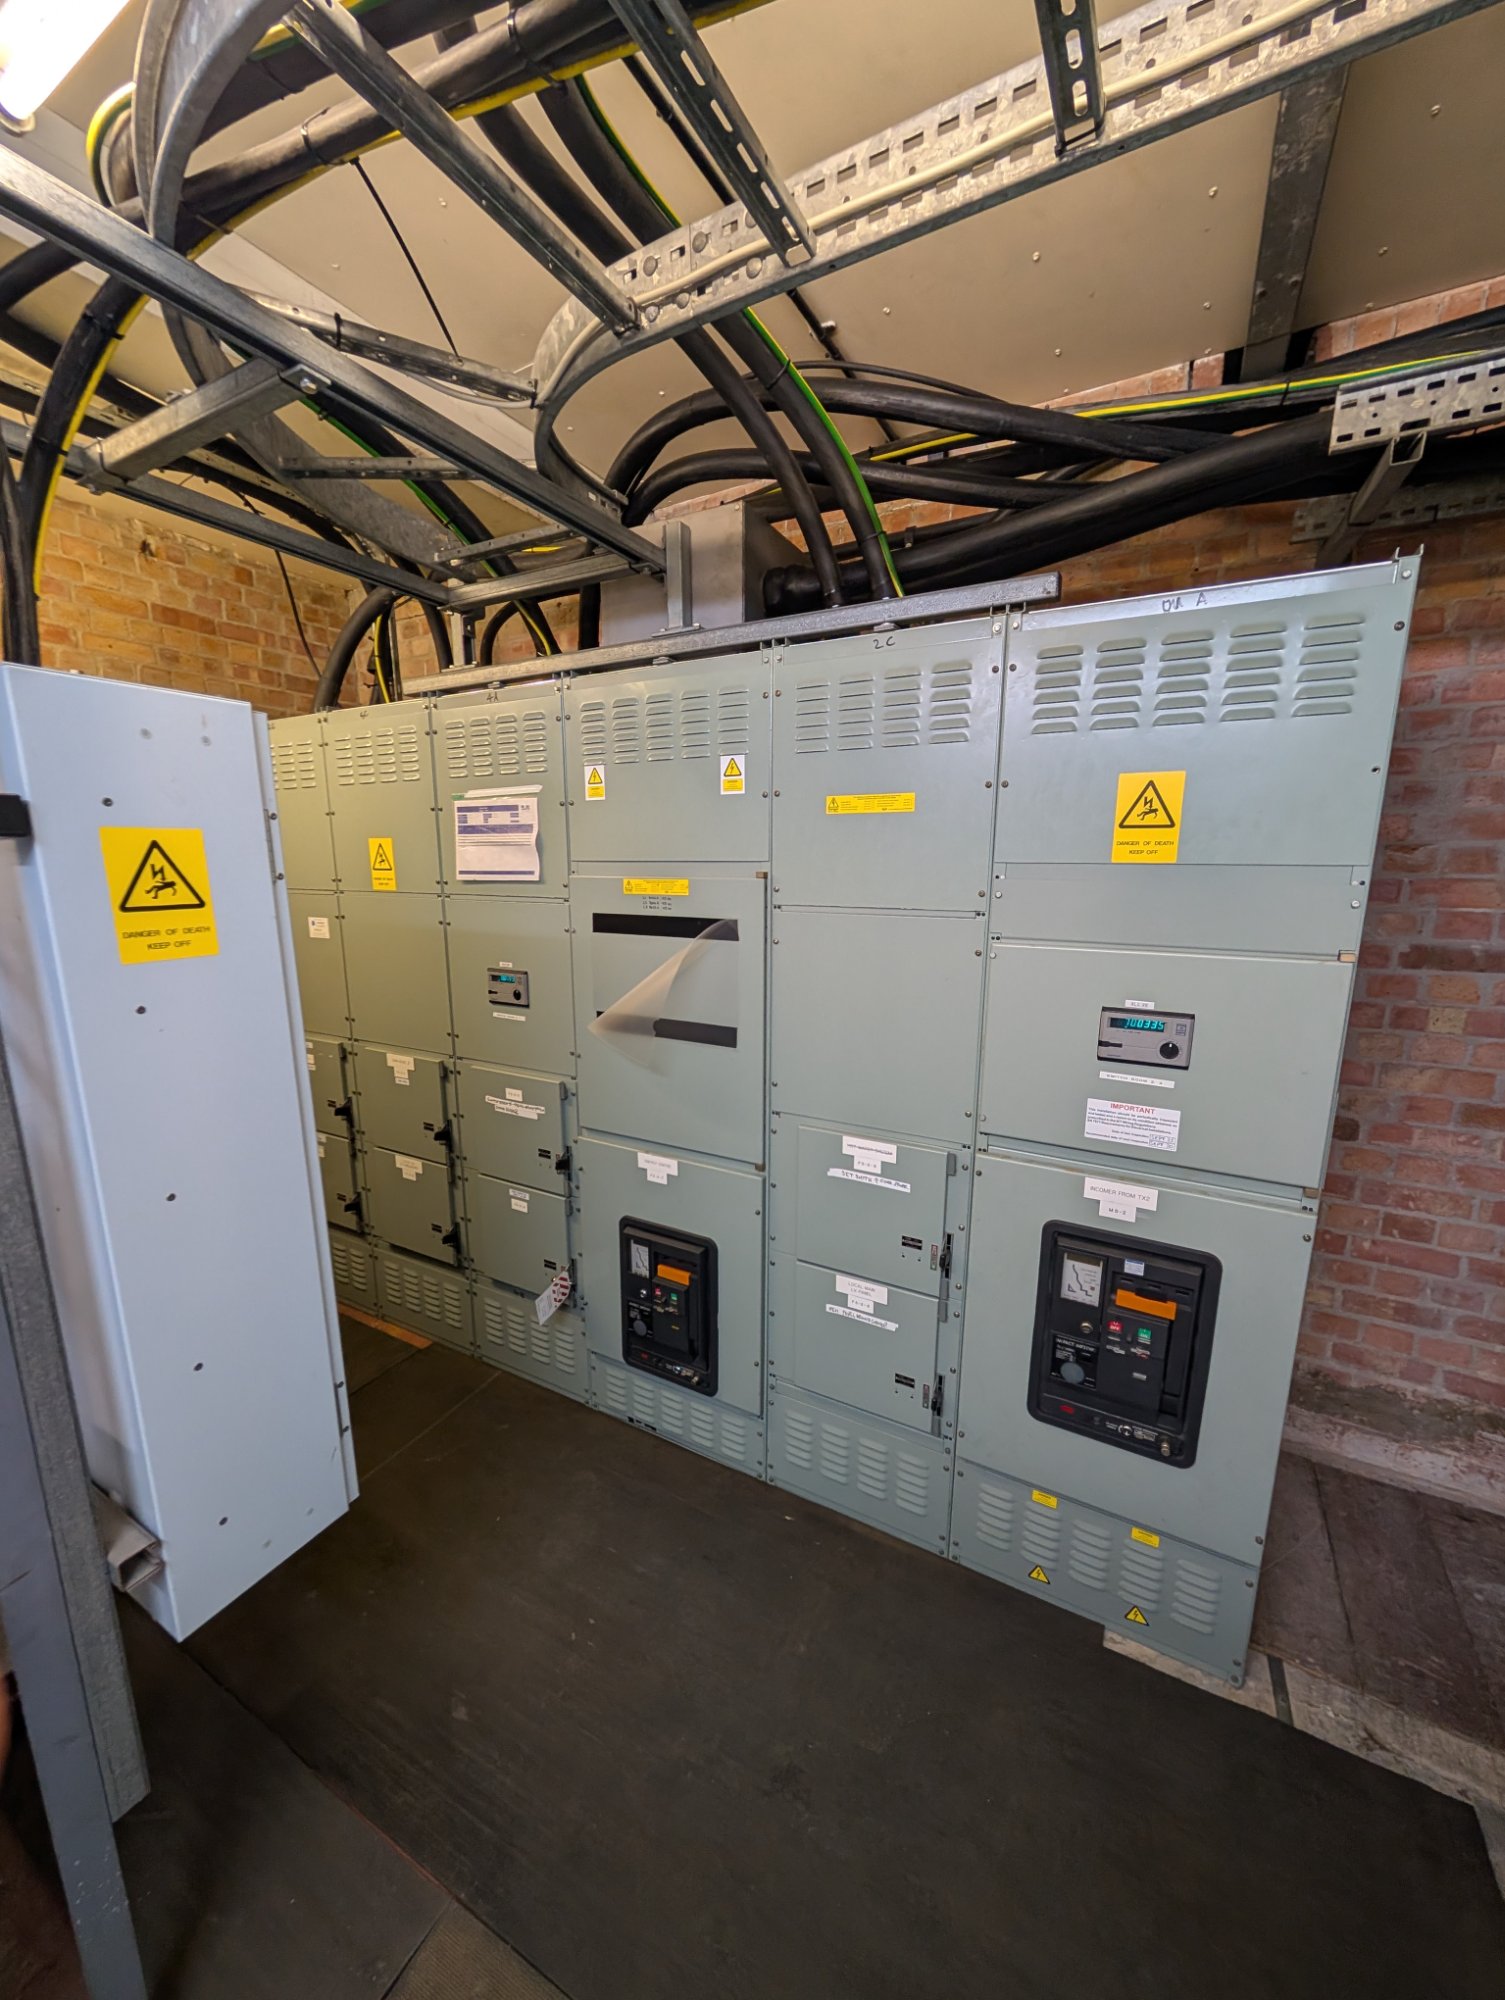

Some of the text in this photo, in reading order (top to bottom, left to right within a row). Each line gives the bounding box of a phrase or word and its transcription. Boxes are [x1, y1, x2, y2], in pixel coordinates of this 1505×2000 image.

[122, 925, 211, 939] DANGER OF DEATH
[147, 939, 192, 951] KEEP OFF
[1110, 1103, 1155, 1115] IMPORTANT
[1090, 1185, 1151, 1202] INCOMER FROM TX2
